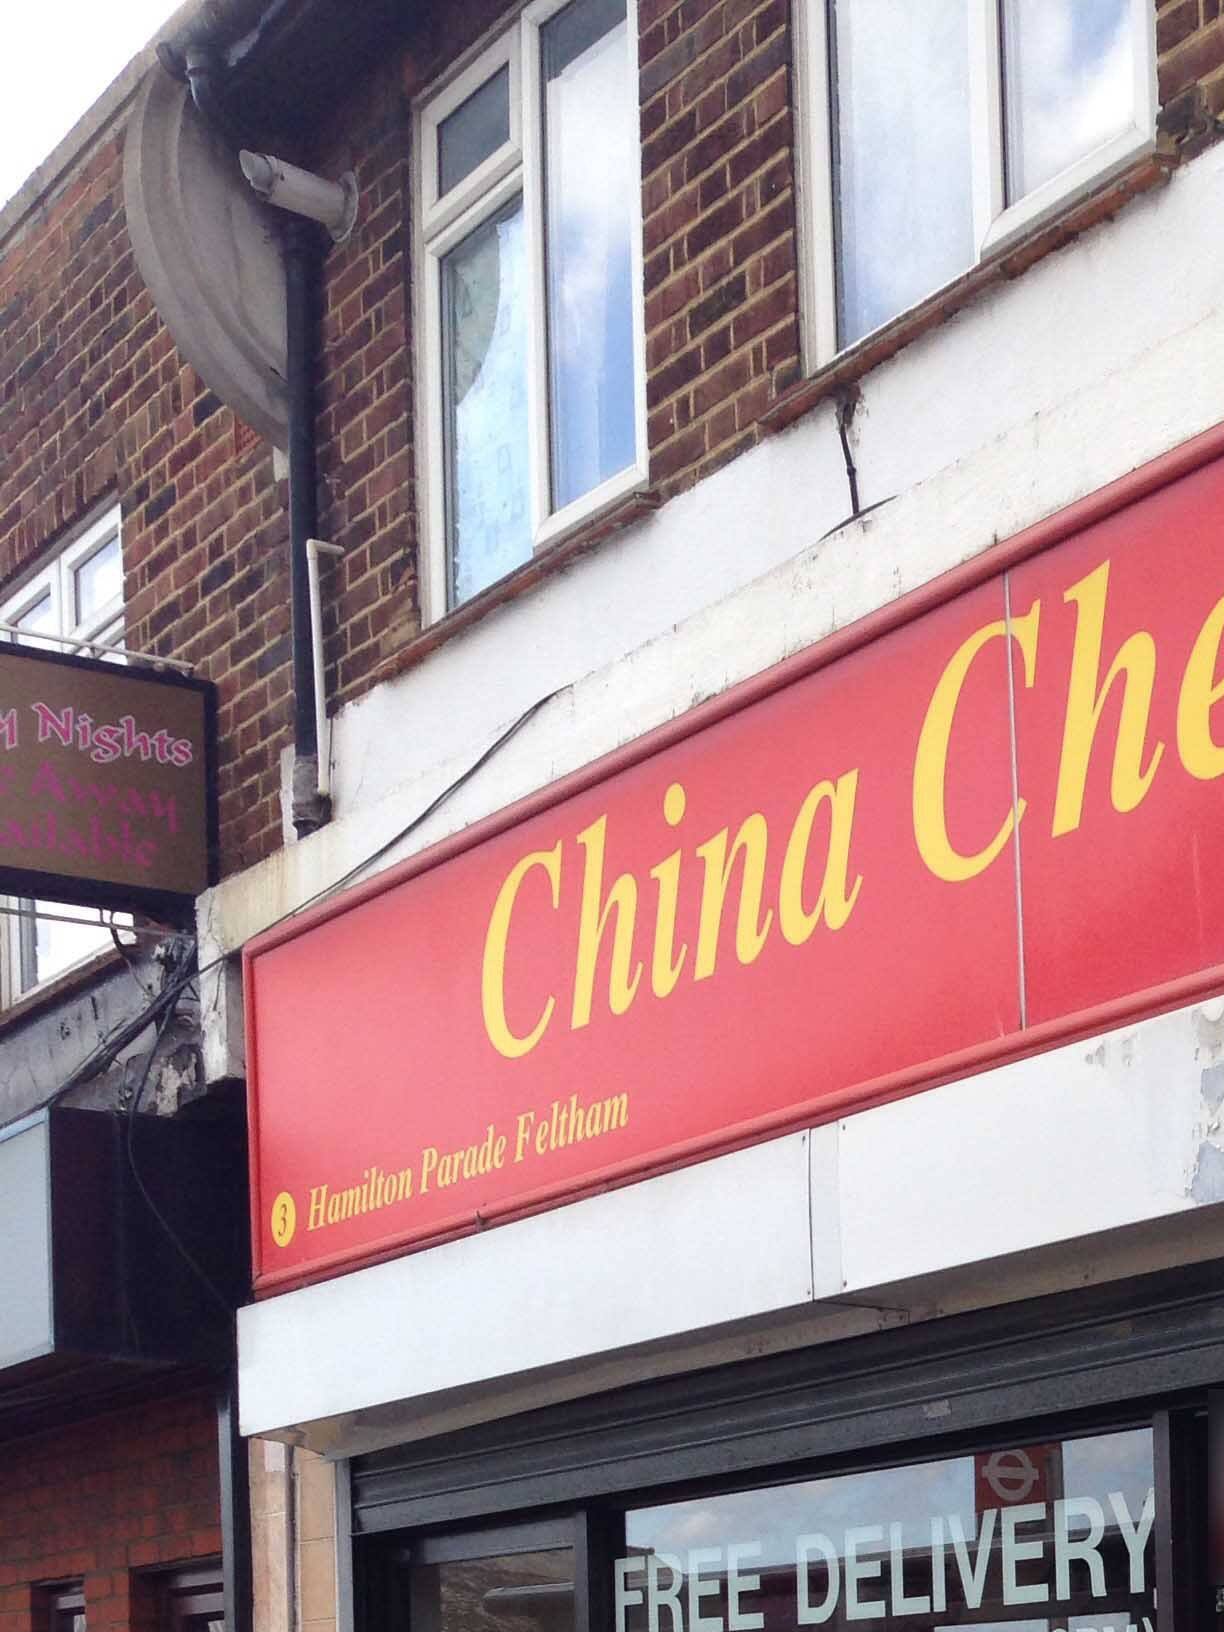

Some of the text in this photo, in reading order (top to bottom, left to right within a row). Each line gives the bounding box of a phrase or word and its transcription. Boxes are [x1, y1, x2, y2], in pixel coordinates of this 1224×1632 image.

[30, 758, 181, 834] Away
[31, 702, 193, 767] Nights
[480, 768, 864, 1059] China
[307, 1166, 413, 1232] Hamilton
[420, 1123, 506, 1195] Parade
[515, 1092, 629, 1162] Feltham
[794, 1487, 1156, 1626] DELIVERY
